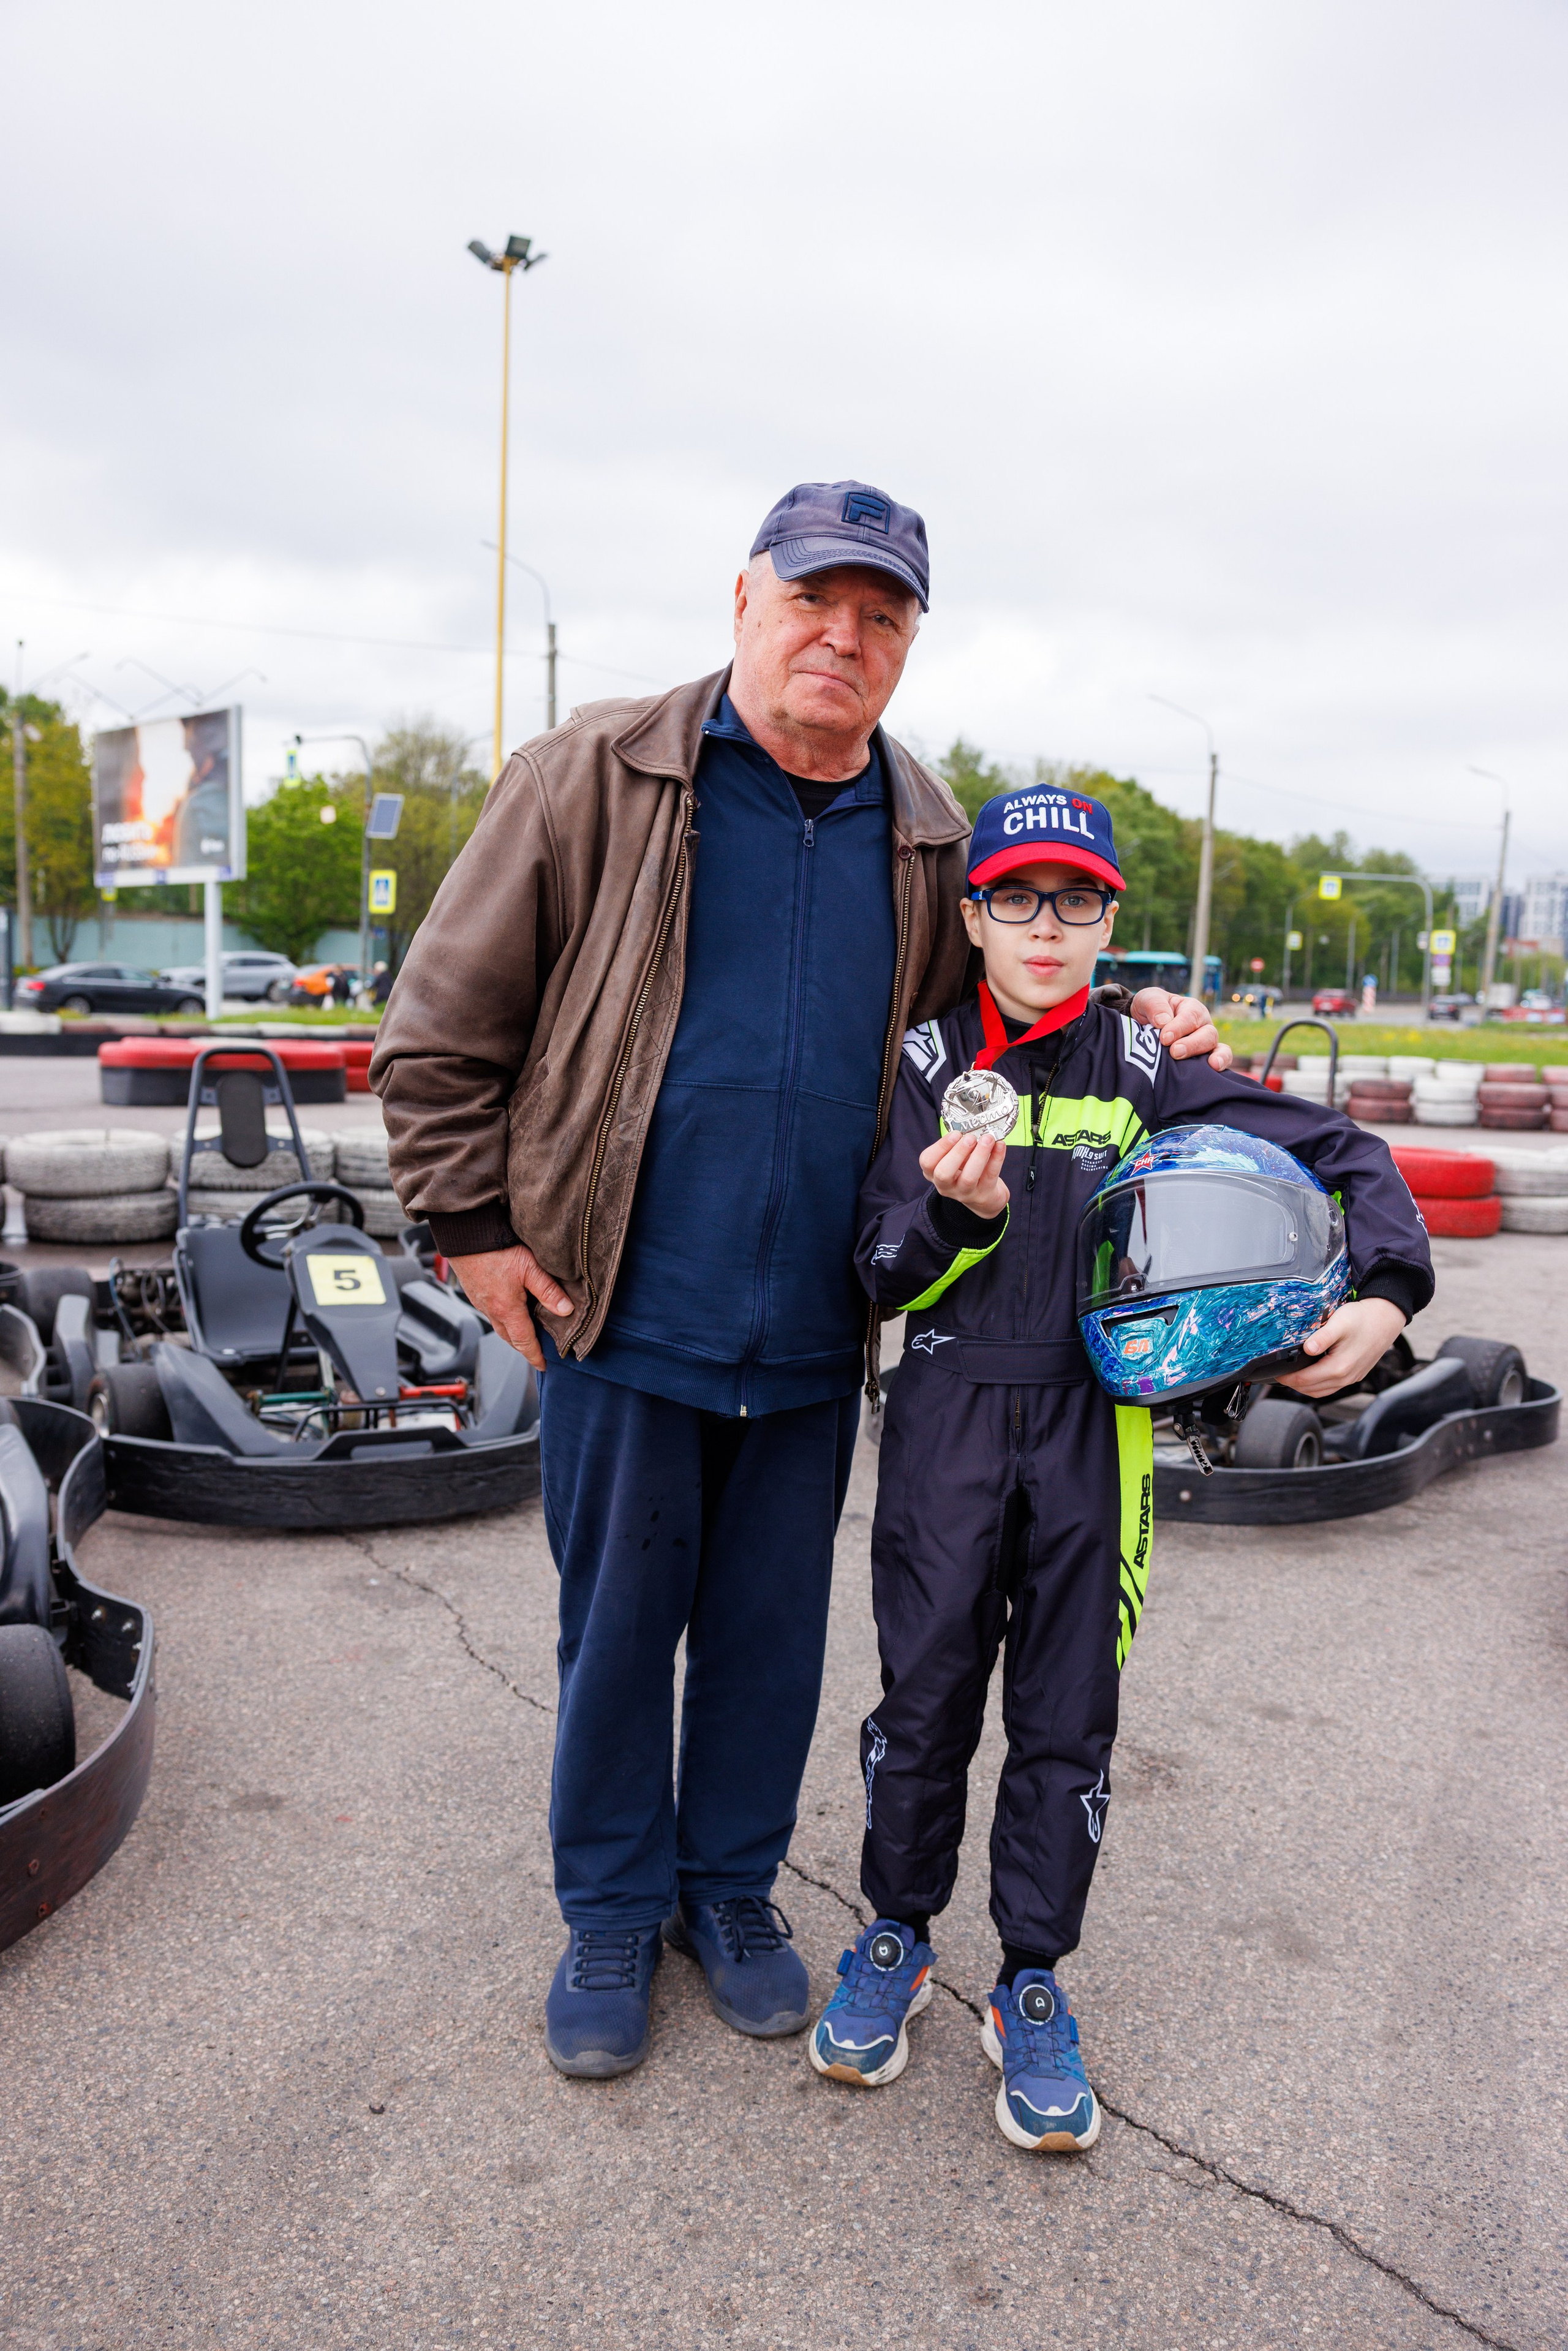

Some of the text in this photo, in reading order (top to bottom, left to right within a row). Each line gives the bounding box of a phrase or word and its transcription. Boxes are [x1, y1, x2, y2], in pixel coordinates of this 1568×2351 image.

[1003, 794, 1093, 815] ALWAYS ON
[1003, 807, 1095, 840] CHILL
[1051, 1129, 1112, 1147] ASTARS
[1094, 1150, 1107, 1160] SUIT
[334, 1269, 361, 1291] 5
[1133, 1473, 1151, 1570] ASTARS
